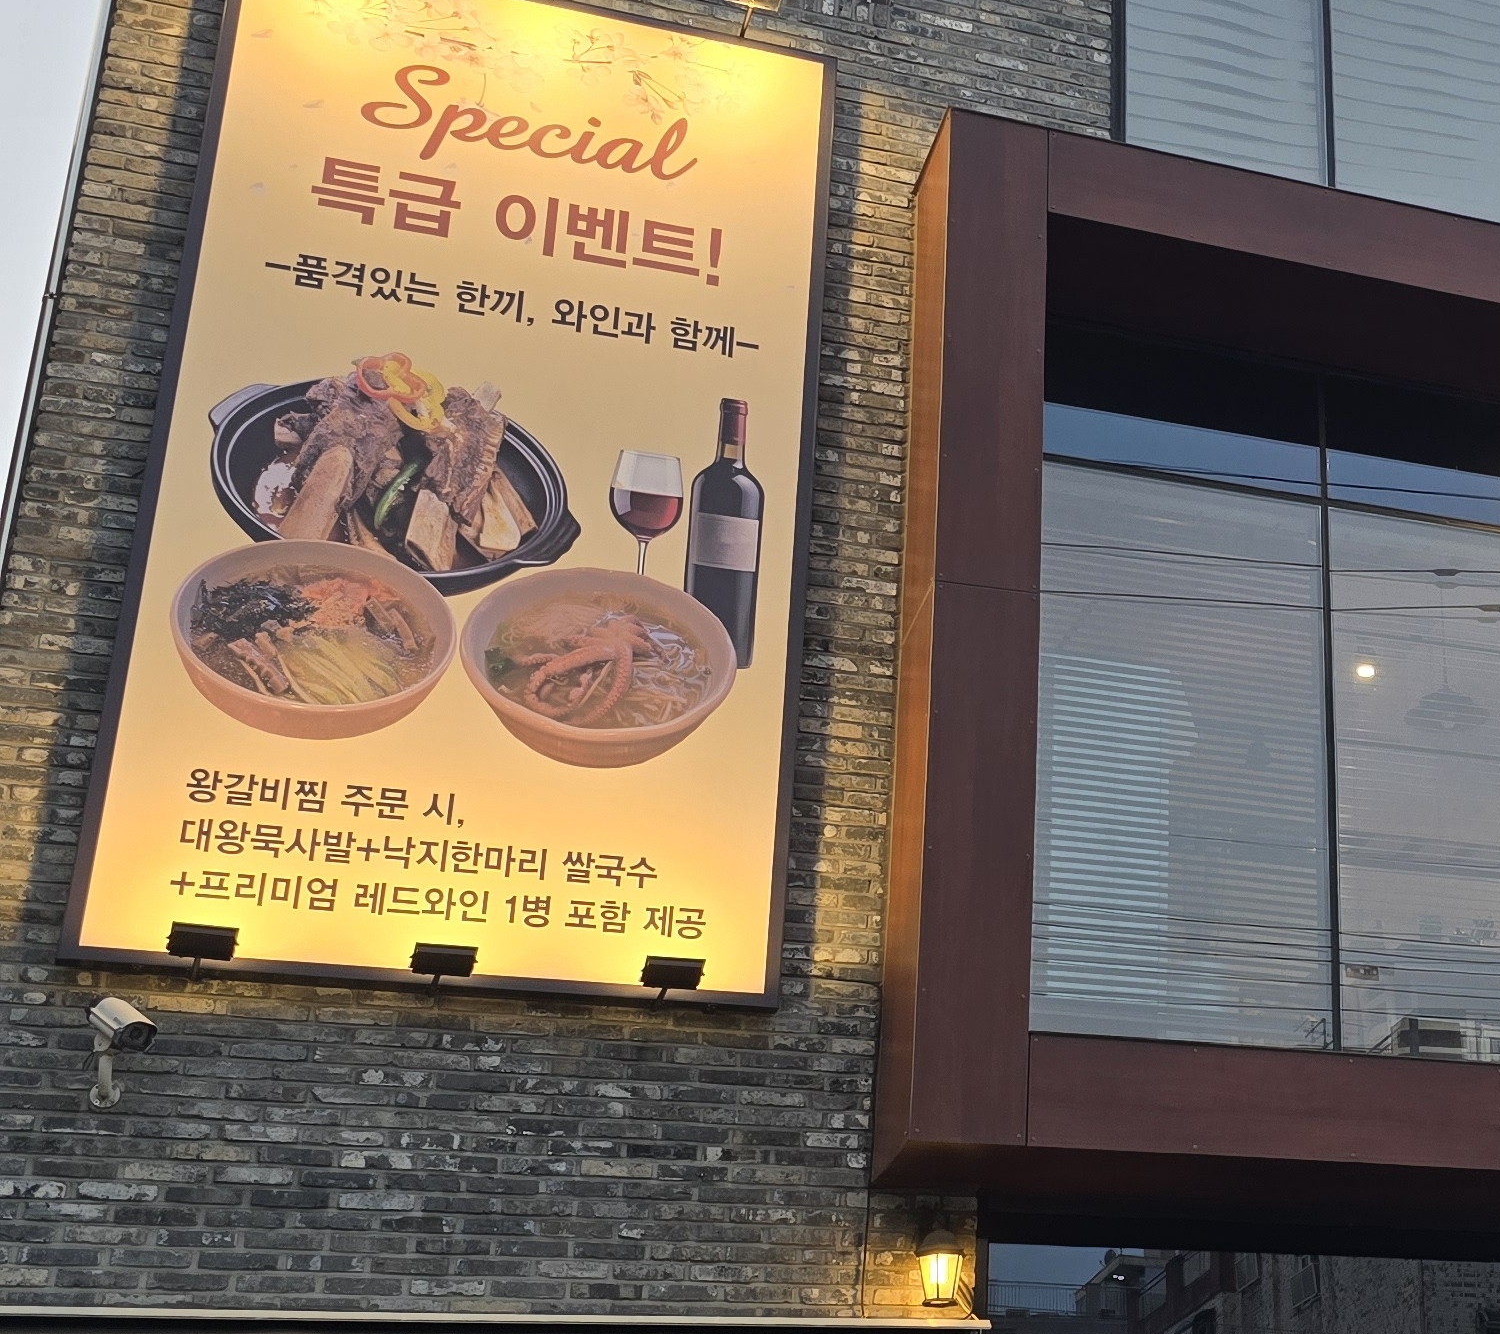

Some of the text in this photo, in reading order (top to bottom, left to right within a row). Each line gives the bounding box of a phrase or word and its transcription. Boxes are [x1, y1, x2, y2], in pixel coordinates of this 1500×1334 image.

[361, 62, 699, 182] Special
[310, 156, 725, 287] 특급 이벤트!
[455, 279, 535, 328] 한끼,
[553, 294, 656, 345] 와인과
[186, 767, 465, 829] 왕갈비찜 주문 시,
[178, 817, 659, 887] 대왕묵사발+낙지한마리 쌀국수
[170, 868, 708, 941] +프리미엄 레드와인 1병 포함 제공
